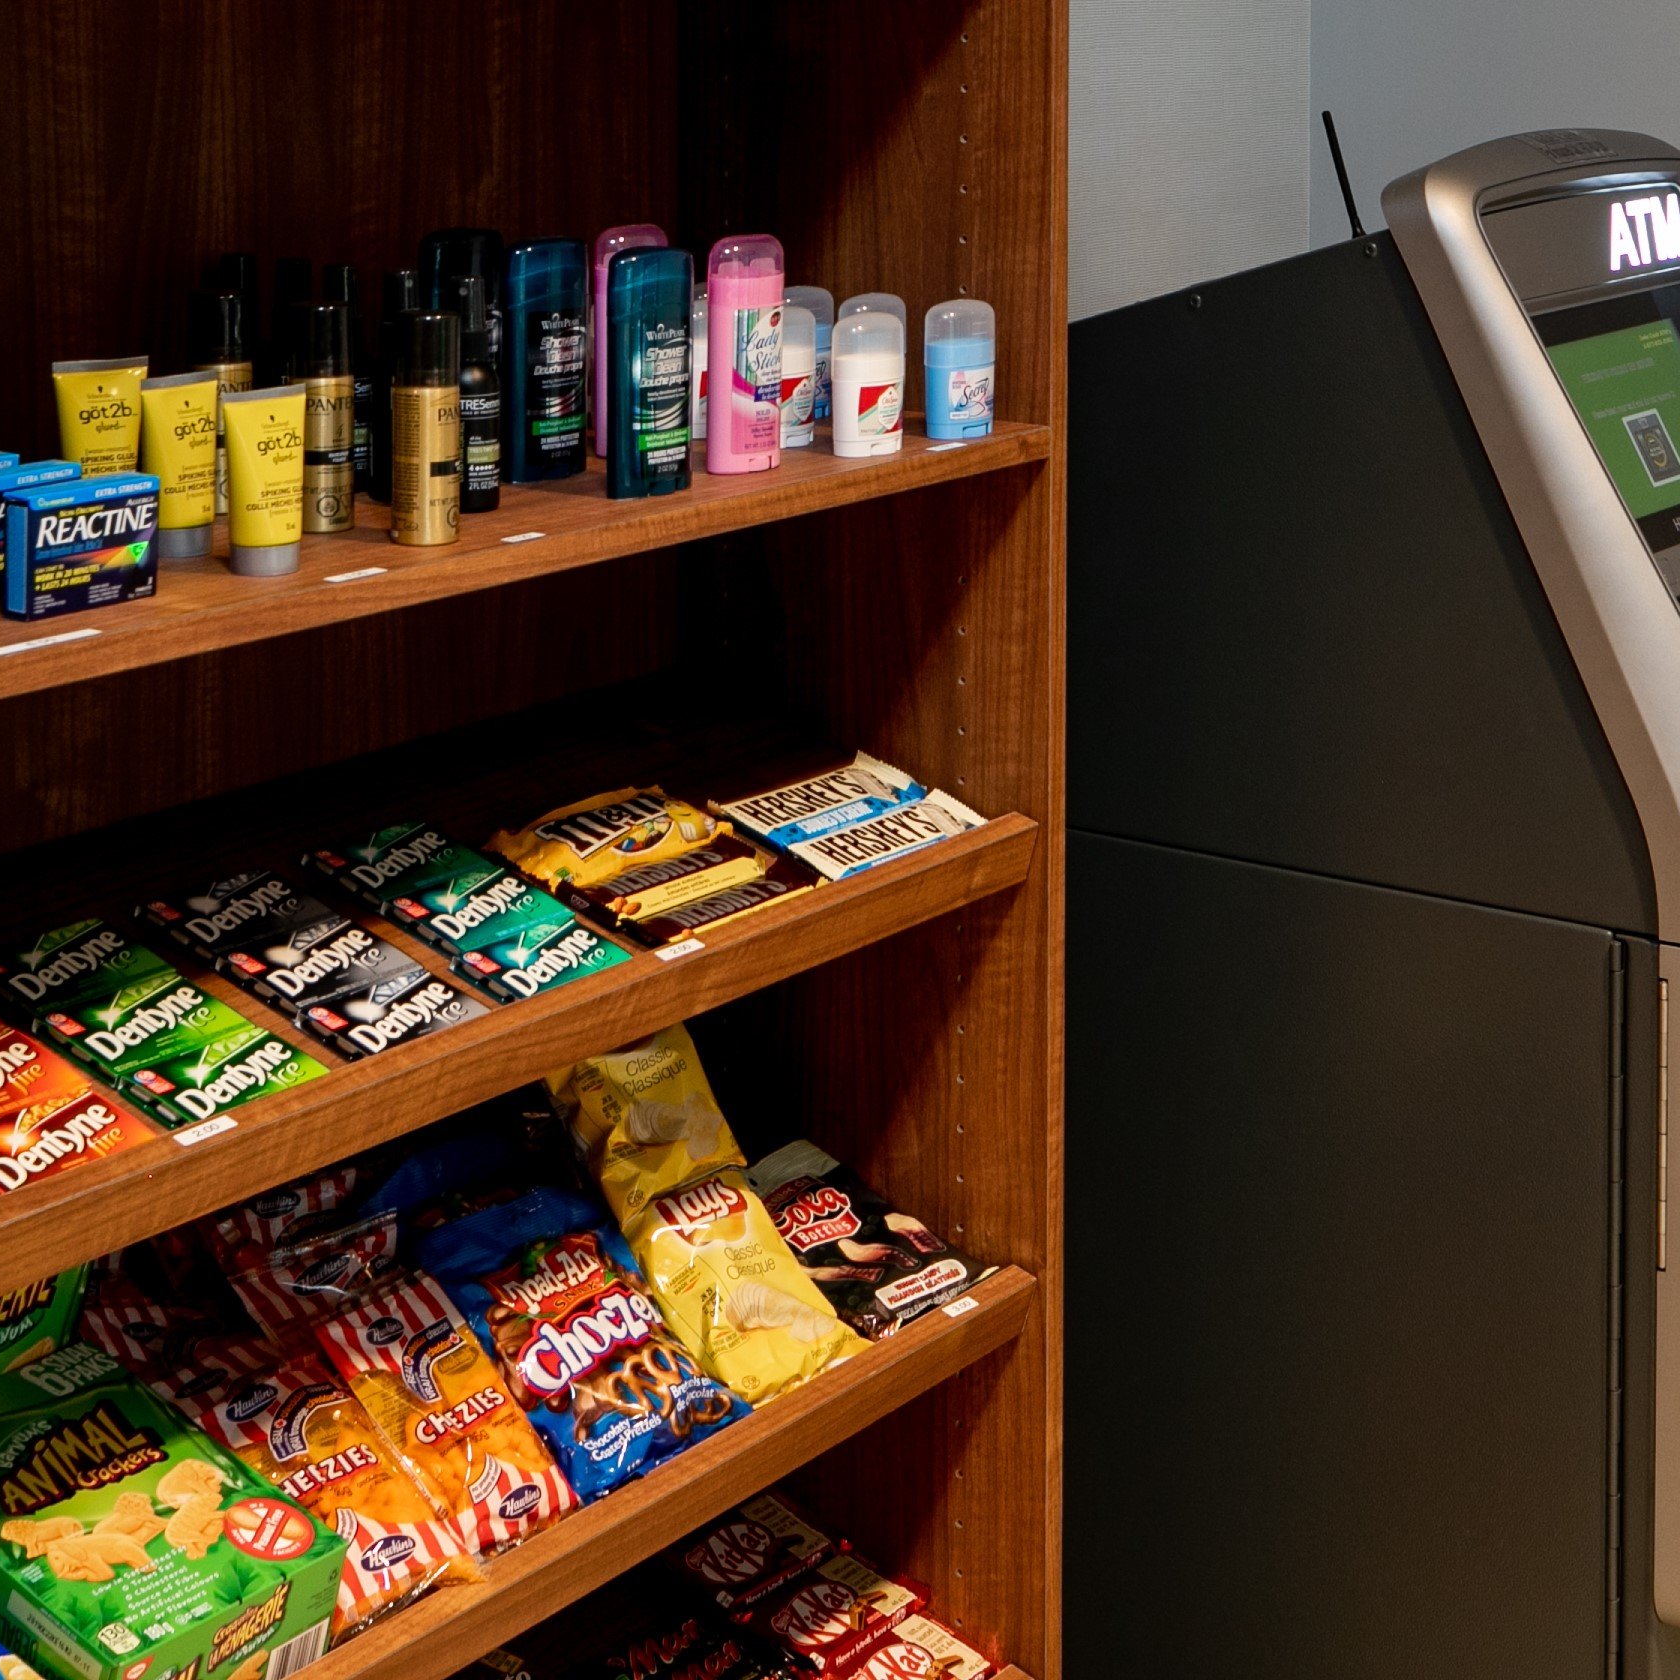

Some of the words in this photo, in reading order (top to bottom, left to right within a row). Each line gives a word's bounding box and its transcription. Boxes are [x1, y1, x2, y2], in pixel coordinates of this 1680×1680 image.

[540, 334, 582, 351] Shower
[645, 345, 688, 362] Shower
[960, 377, 990, 408] Secret
[81, 453, 116, 464] SPIKING
[17, 475, 39, 485] EXTRA
[40, 469, 74, 481] STRENGTH
[95, 487, 117, 498] EXTRA
[117, 480, 153, 494] STRENGTH
[35, 502, 158, 550] REACTINE
[735, 770, 869, 827] HERSHEY'S
[810, 805, 942, 867] HERSHEY'S
[351, 830, 446, 889] Dentyne
[426, 847, 458, 867] ice
[185, 877, 292, 944] Dentyne
[270, 895, 301, 919] ice
[430, 874, 527, 941] Dentyne
[508, 892, 541, 916] ice
[671, 880, 788, 928] HERSHEY'S
[8, 928, 125, 1001] Dentyne
[101, 947, 139, 975] ice
[267, 926, 374, 998] Dentyne
[351, 946, 388, 970] ice
[502, 926, 598, 999] Dentyne
[576, 944, 608, 970] ice
[84, 985, 204, 1062] Dentyne
[177, 1004, 217, 1036] ice
[348, 979, 455, 1054] Dentyne
[432, 999, 469, 1023] ice
[266, 1059, 308, 1088] ice
[626, 1045, 674, 1077] Classic
[6, 1061, 46, 1097] fire
[175, 1039, 293, 1120] Dentyne
[623, 1058, 688, 1098] Classique
[86, 1124, 126, 1159] fire
[192, 1121, 220, 1138] 2.00
[670, 1178, 741, 1233] Lay's
[797, 1220, 853, 1245] Bottles
[297, 1256, 349, 1291] Hawkins
[41, 1340, 98, 1370] SNAK
[21, 1356, 68, 1397] 6
[67, 1350, 120, 1394] PAKS
[231, 1386, 278, 1418] Hawkins
[584, 1417, 631, 1451] Chocolaty
[624, 1413, 662, 1440] Pretzels
[2, 1408, 149, 1513] ANIMAL
[76, 1447, 161, 1488] Crackers
[502, 1486, 542, 1517] Hawkins
[369, 1537, 415, 1568] Hawkins
[700, 1521, 769, 1584] KitKat
[92, 1583, 112, 1596] Low
[127, 1591, 161, 1610] Source
[162, 1582, 174, 1594] of
[175, 1571, 200, 1586] Fibre
[130, 1571, 158, 1586] Trans
[134, 1565, 188, 1596] Cholesterol
[124, 1613, 139, 1624] No
[139, 1590, 184, 1617] Artificial
[184, 1571, 220, 1593] Colours
[154, 1611, 165, 1620] or
[166, 1589, 207, 1613] Flavours
[786, 1582, 856, 1646] KitKat
[100, 1623, 126, 1642] 130
[835, 1651, 851, 1667] Have
